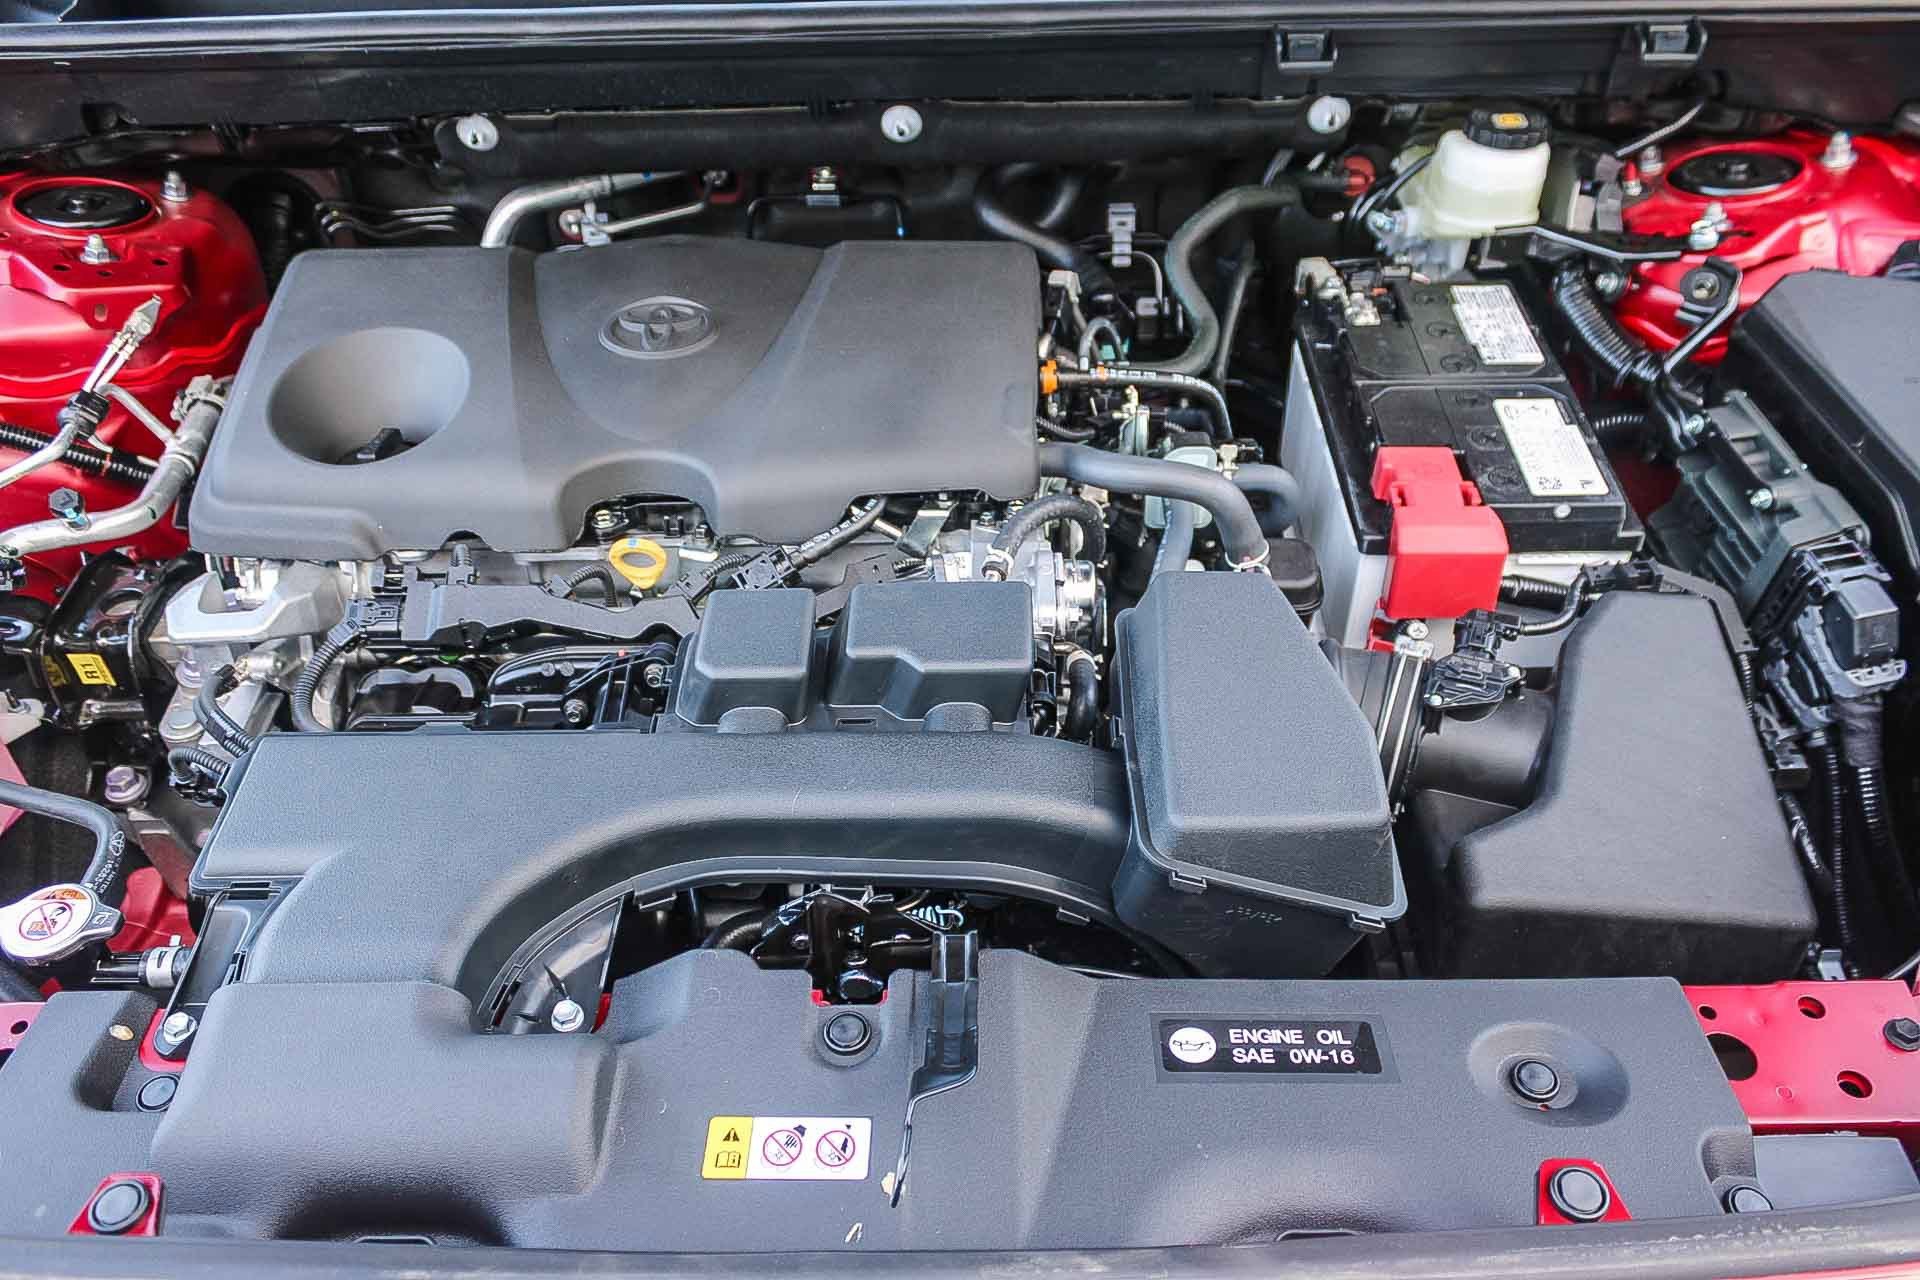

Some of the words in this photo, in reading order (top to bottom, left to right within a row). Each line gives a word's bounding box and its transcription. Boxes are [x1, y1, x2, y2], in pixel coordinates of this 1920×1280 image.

[1228, 1028, 1305, 1045] ENGINE
[1316, 1029, 1352, 1045] OIL
[1232, 1048, 1276, 1064] SAE
[1289, 1049, 1355, 1065] 0W-16
